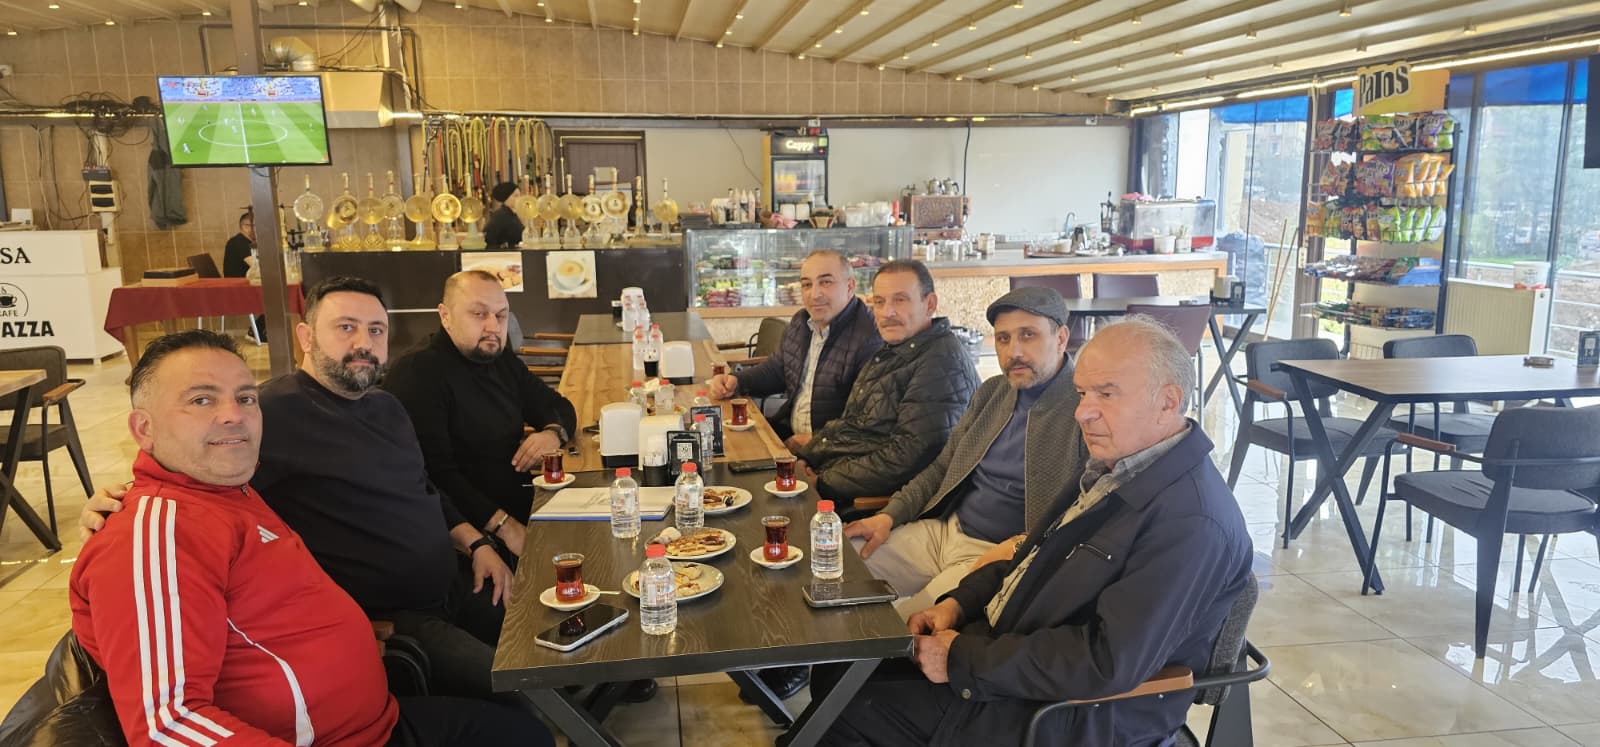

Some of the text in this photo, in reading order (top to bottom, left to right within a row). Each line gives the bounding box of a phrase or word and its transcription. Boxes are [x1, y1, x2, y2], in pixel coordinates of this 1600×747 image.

[785, 139, 814, 151] Cappy
[0, 246, 31, 264] SA
[2, 321, 55, 338] AZZA
